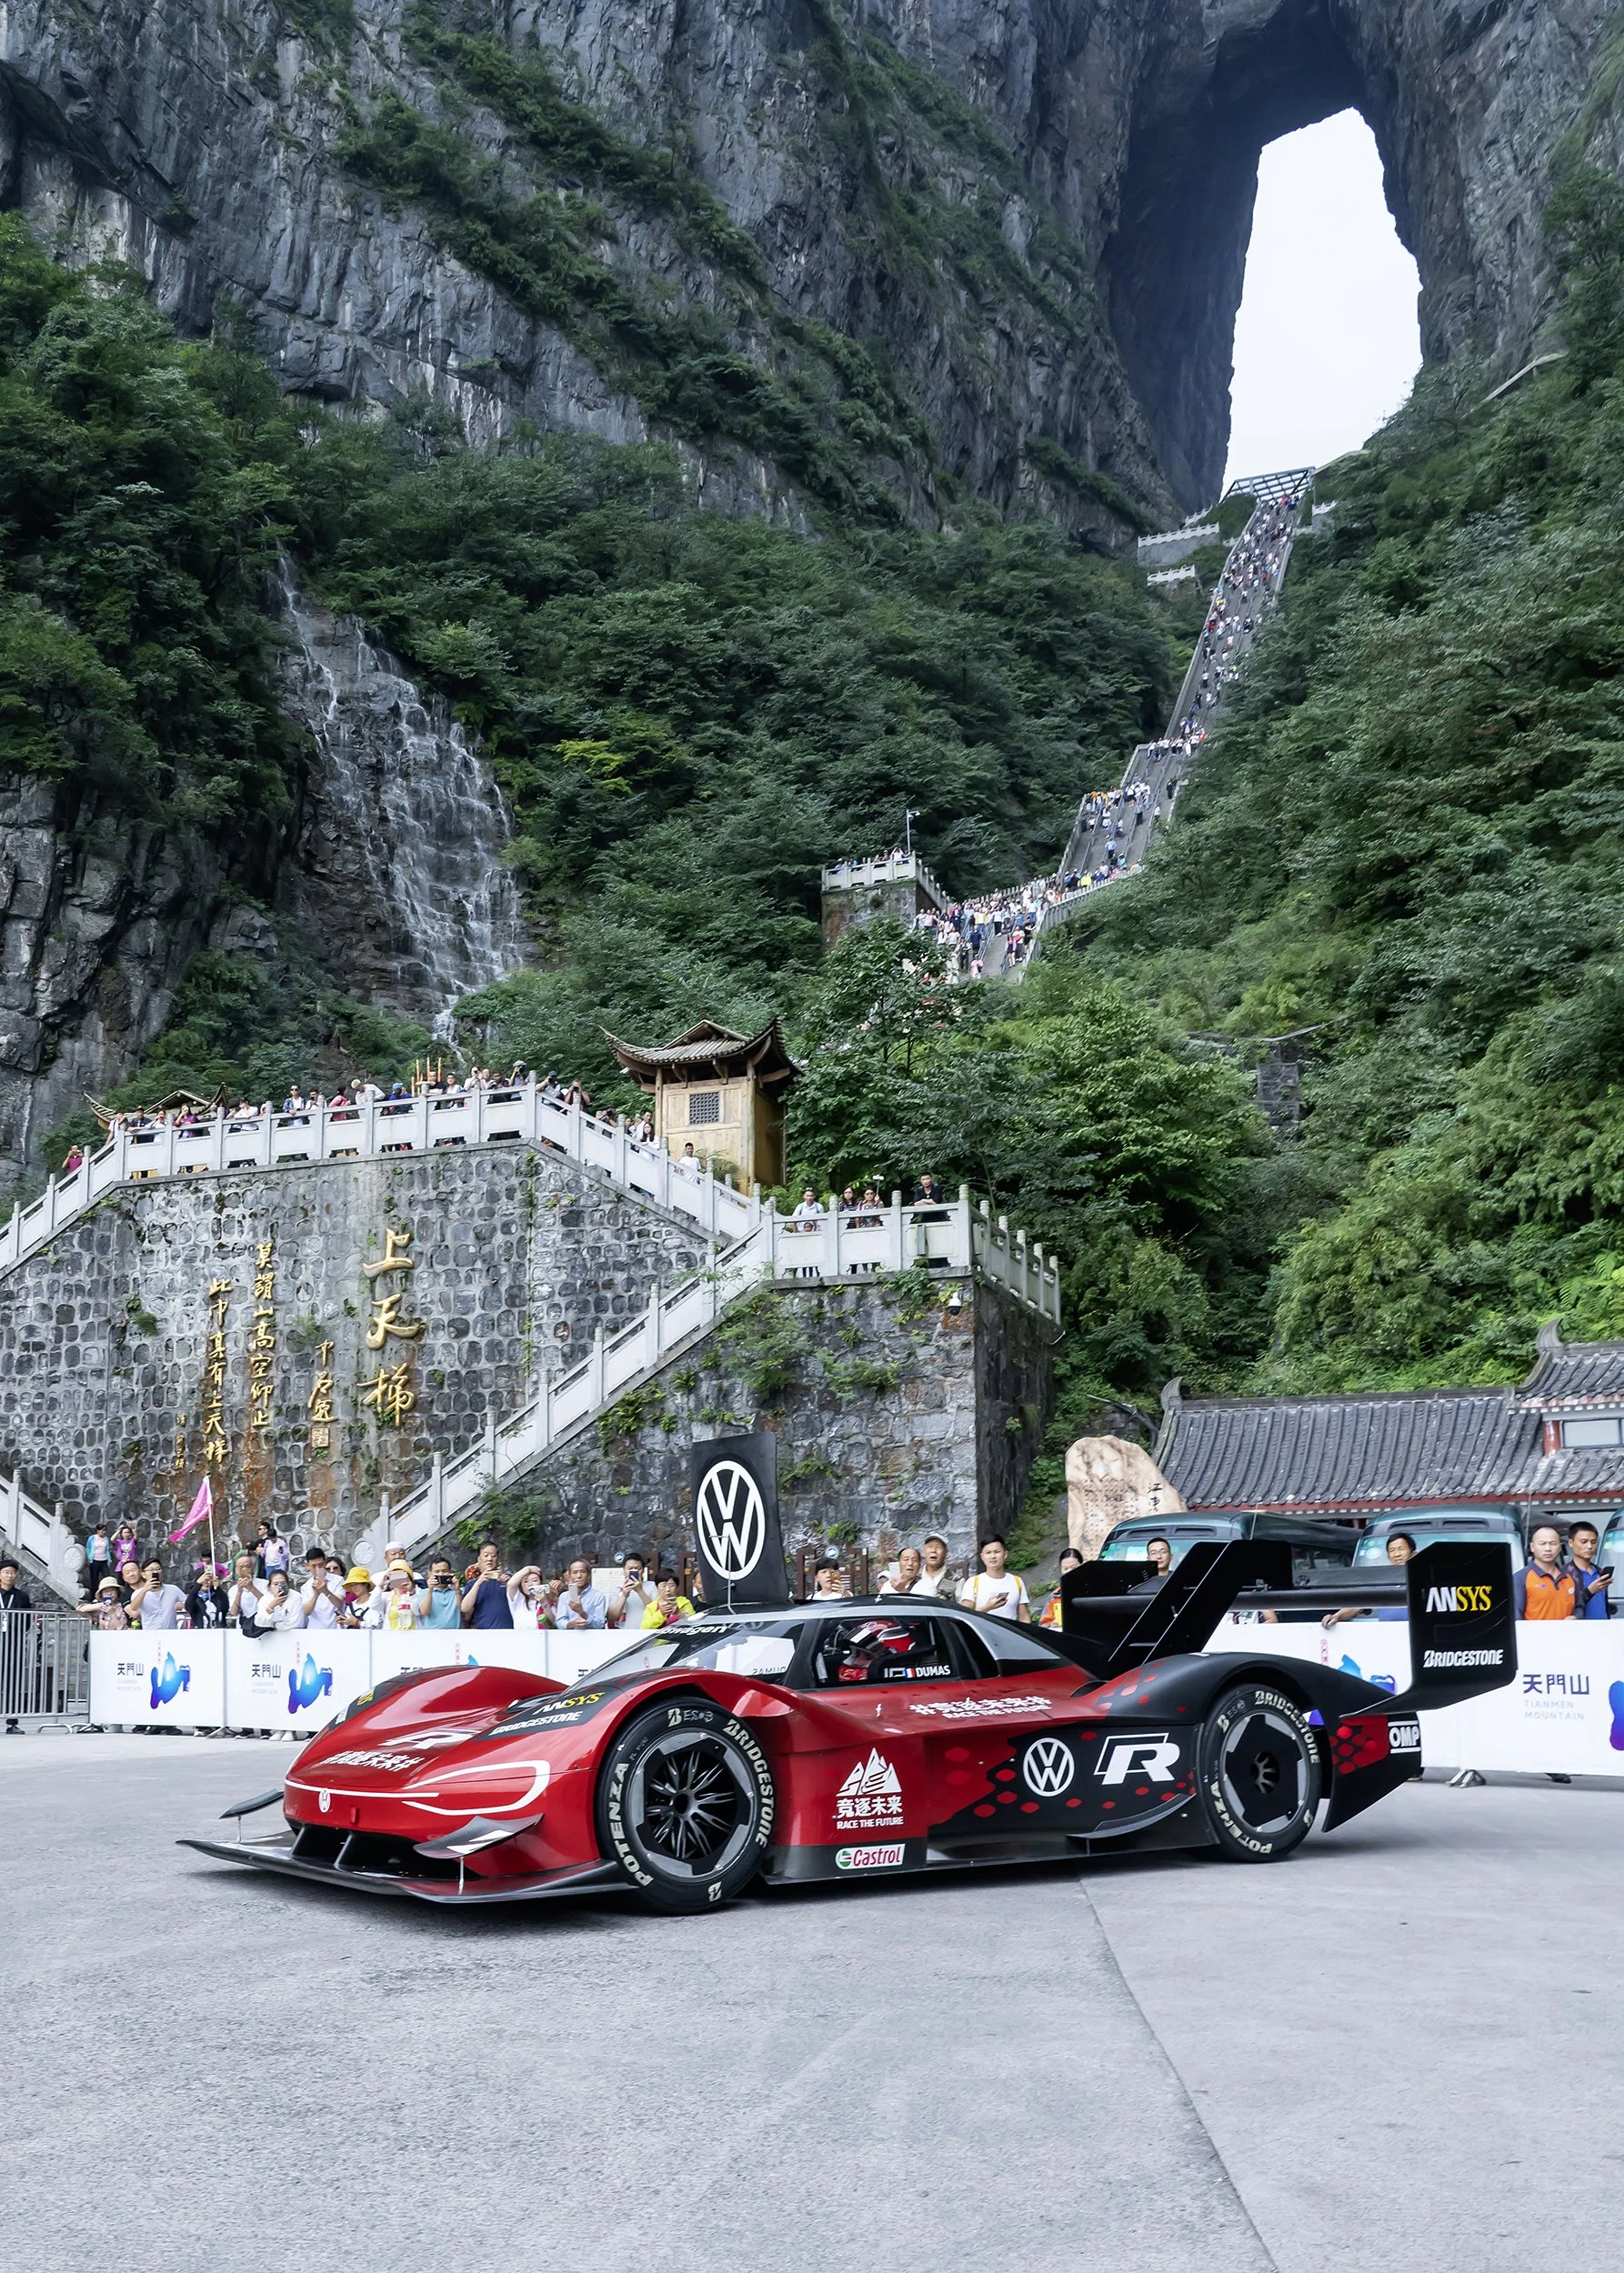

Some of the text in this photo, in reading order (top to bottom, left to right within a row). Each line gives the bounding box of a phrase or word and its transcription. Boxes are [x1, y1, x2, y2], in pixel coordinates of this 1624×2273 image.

[356, 1228, 418, 1427] 上天梯
[1426, 1586, 1492, 1612] ANSYS
[1423, 1649, 1503, 1667] BRIDGESTONE
[117, 1662, 144, 1676] 天門山
[251, 1664, 282, 1677] 天門山
[916, 1666, 951, 1677] DUMAS
[1523, 1674, 1589, 1695] 天門山
[532, 1692, 606, 1716] ANSYS
[1524, 1699, 1574, 1709] TIANMEN
[488, 1711, 583, 1737] BRIDGESTONE
[1524, 1711, 1585, 1721] MOUNTAIN
[1389, 1726, 1419, 1747] OMP
[723, 1718, 775, 1849] BRIDGESTONE
[836, 1795, 903, 1819] 竞逐未来
[608, 1763, 654, 1887] POTENZA
[837, 1816, 904, 1829] RACE THE FUTURE
[853, 1847, 901, 1867] Castrol
